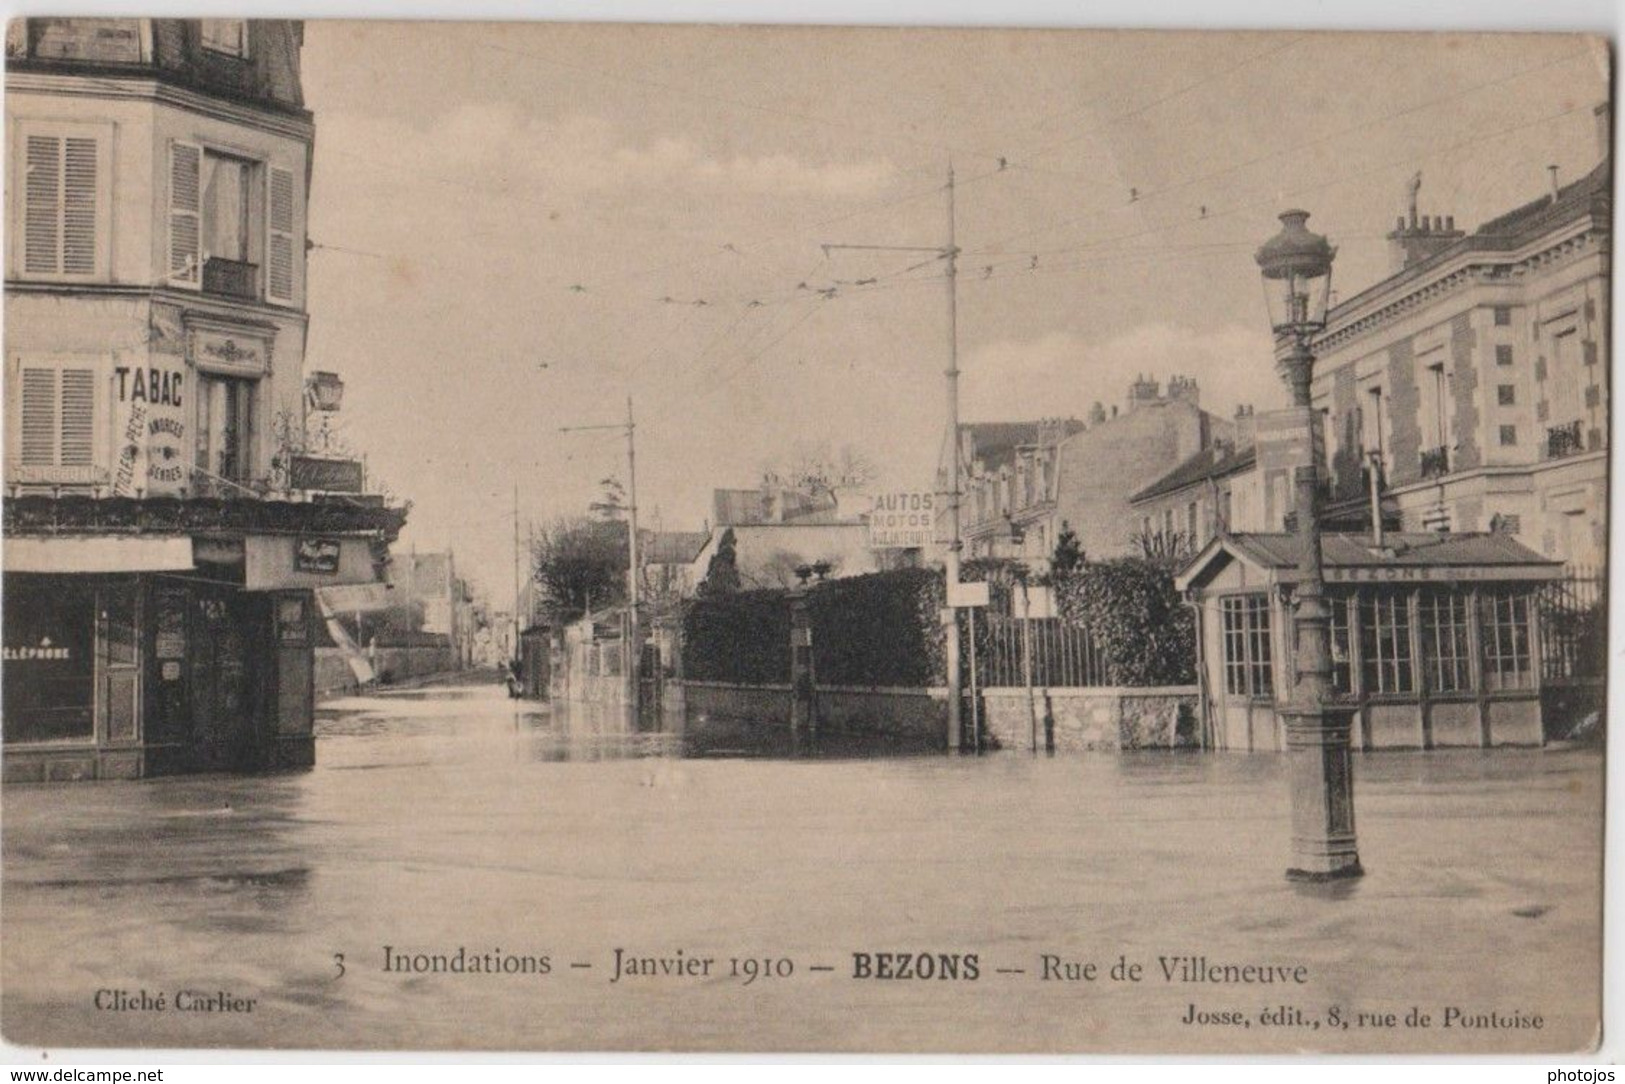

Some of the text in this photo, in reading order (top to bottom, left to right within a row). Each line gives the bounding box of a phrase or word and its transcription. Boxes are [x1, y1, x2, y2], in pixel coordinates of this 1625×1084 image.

[115, 366, 183, 407] TABAC
[875, 493, 933, 511] AUTOS
[873, 514, 930, 527] MOTOS
[1333, 566, 1431, 580] BEZONS
[3, 646, 70, 660] ÉLÉPHONE
